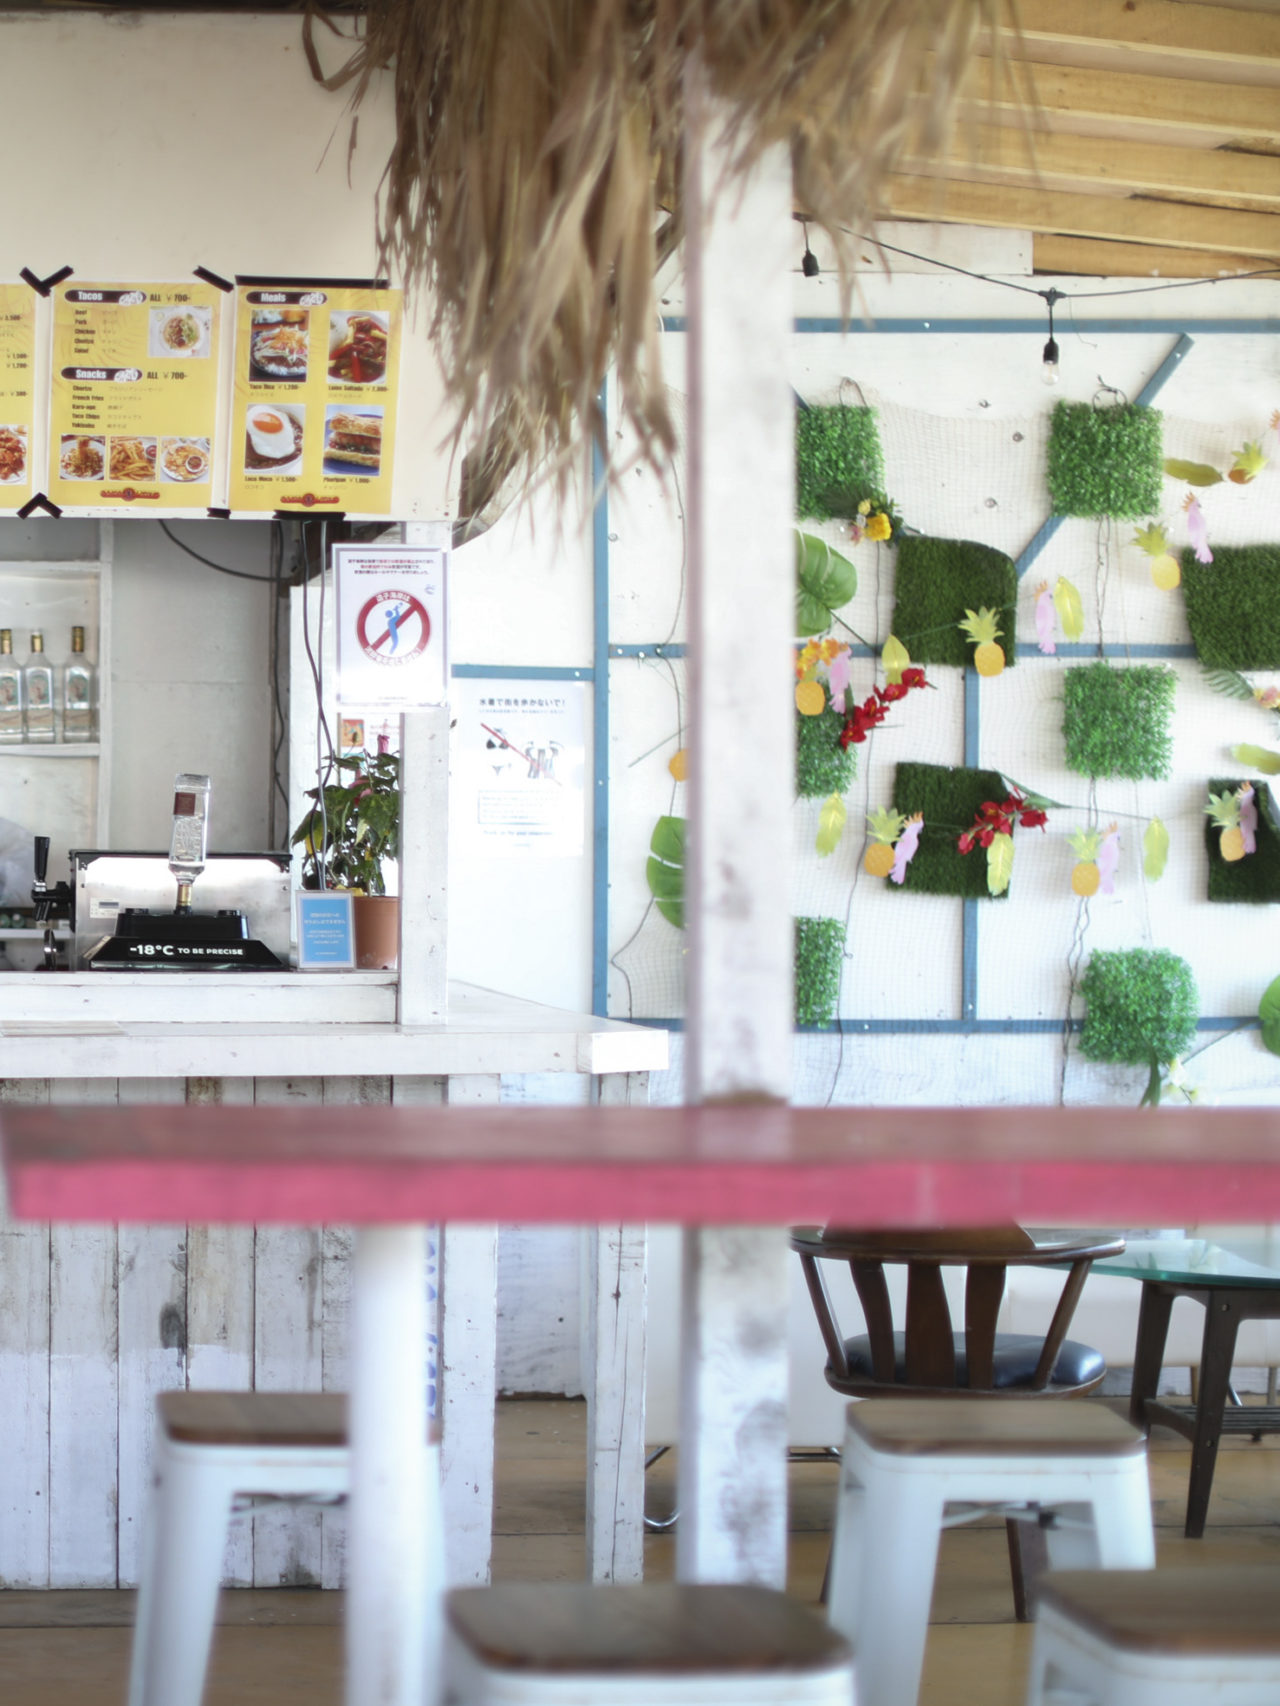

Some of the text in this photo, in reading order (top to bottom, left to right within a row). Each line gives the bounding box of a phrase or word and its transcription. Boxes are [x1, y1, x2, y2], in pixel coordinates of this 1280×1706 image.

[78, 291, 103, 301] Tacos
[150, 294, 161, 302] ALL
[261, 293, 286, 303] Meals
[75, 369, 107, 379] Snacks
[147, 371, 158, 380] ALL
[130, 945, 174, 955] -18°C
